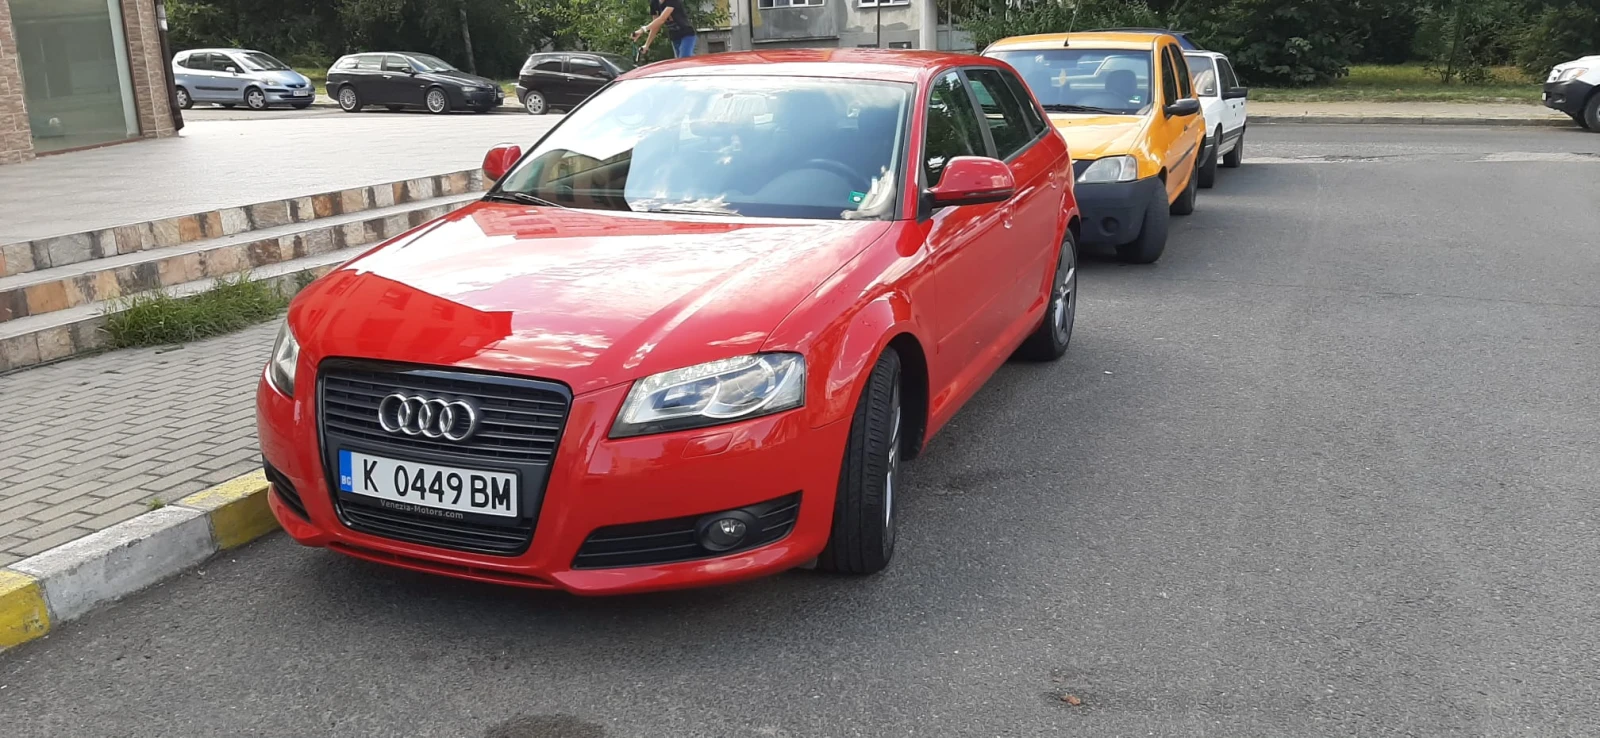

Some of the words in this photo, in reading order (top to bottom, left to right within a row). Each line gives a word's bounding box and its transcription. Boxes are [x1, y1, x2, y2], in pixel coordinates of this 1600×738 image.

[341, 475, 352, 486] BG
[363, 458, 379, 493] K
[380, 499, 464, 519] Venezia-Motors.com
